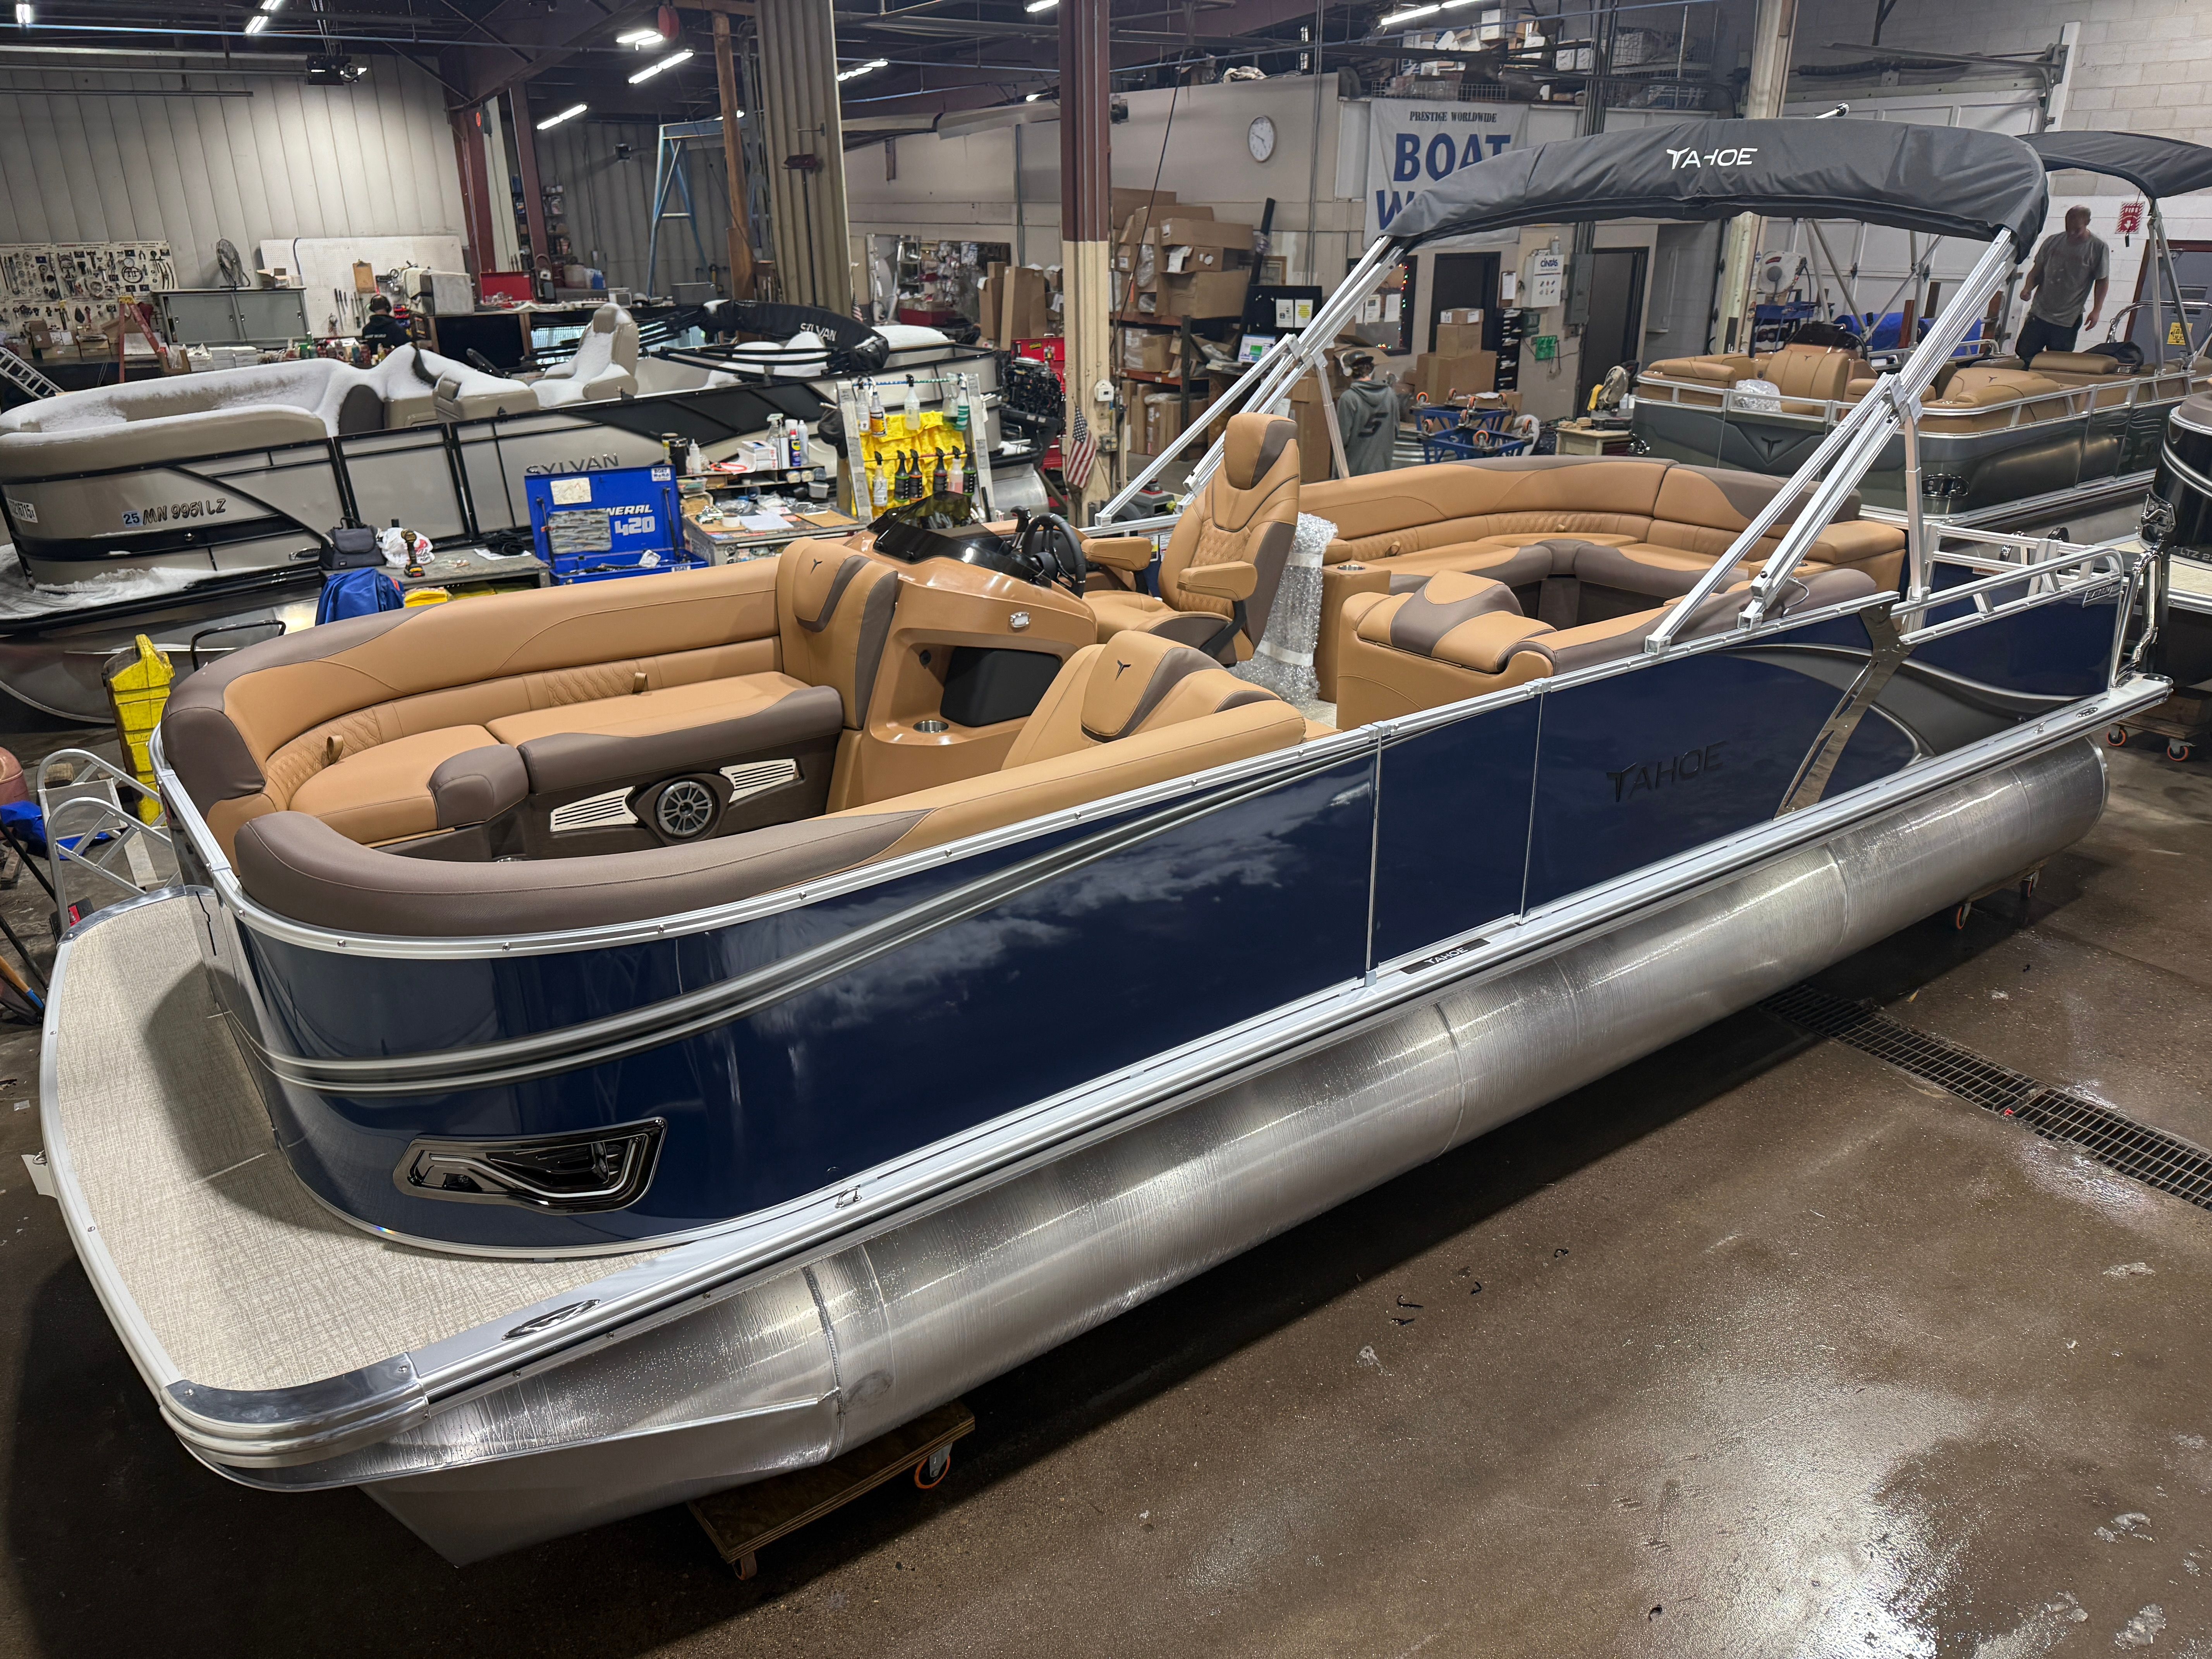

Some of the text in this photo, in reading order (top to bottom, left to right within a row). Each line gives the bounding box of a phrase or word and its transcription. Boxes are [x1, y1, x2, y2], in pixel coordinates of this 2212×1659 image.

[1410, 111, 1497, 123] PRESTIGE WORLDWIDE
[1393, 132, 1511, 182] BOAT
[1666, 147, 1758, 170] TAHOE
[123, 498, 227, 525] 25 MN 9951 LZ
[597, 504, 653, 516] NERAL
[614, 516, 655, 536] 420
[2180, 547, 2212, 562] LTZ 2
[1606, 740, 1729, 802] TAHOE
[1423, 947, 1468, 964] TAHOE
